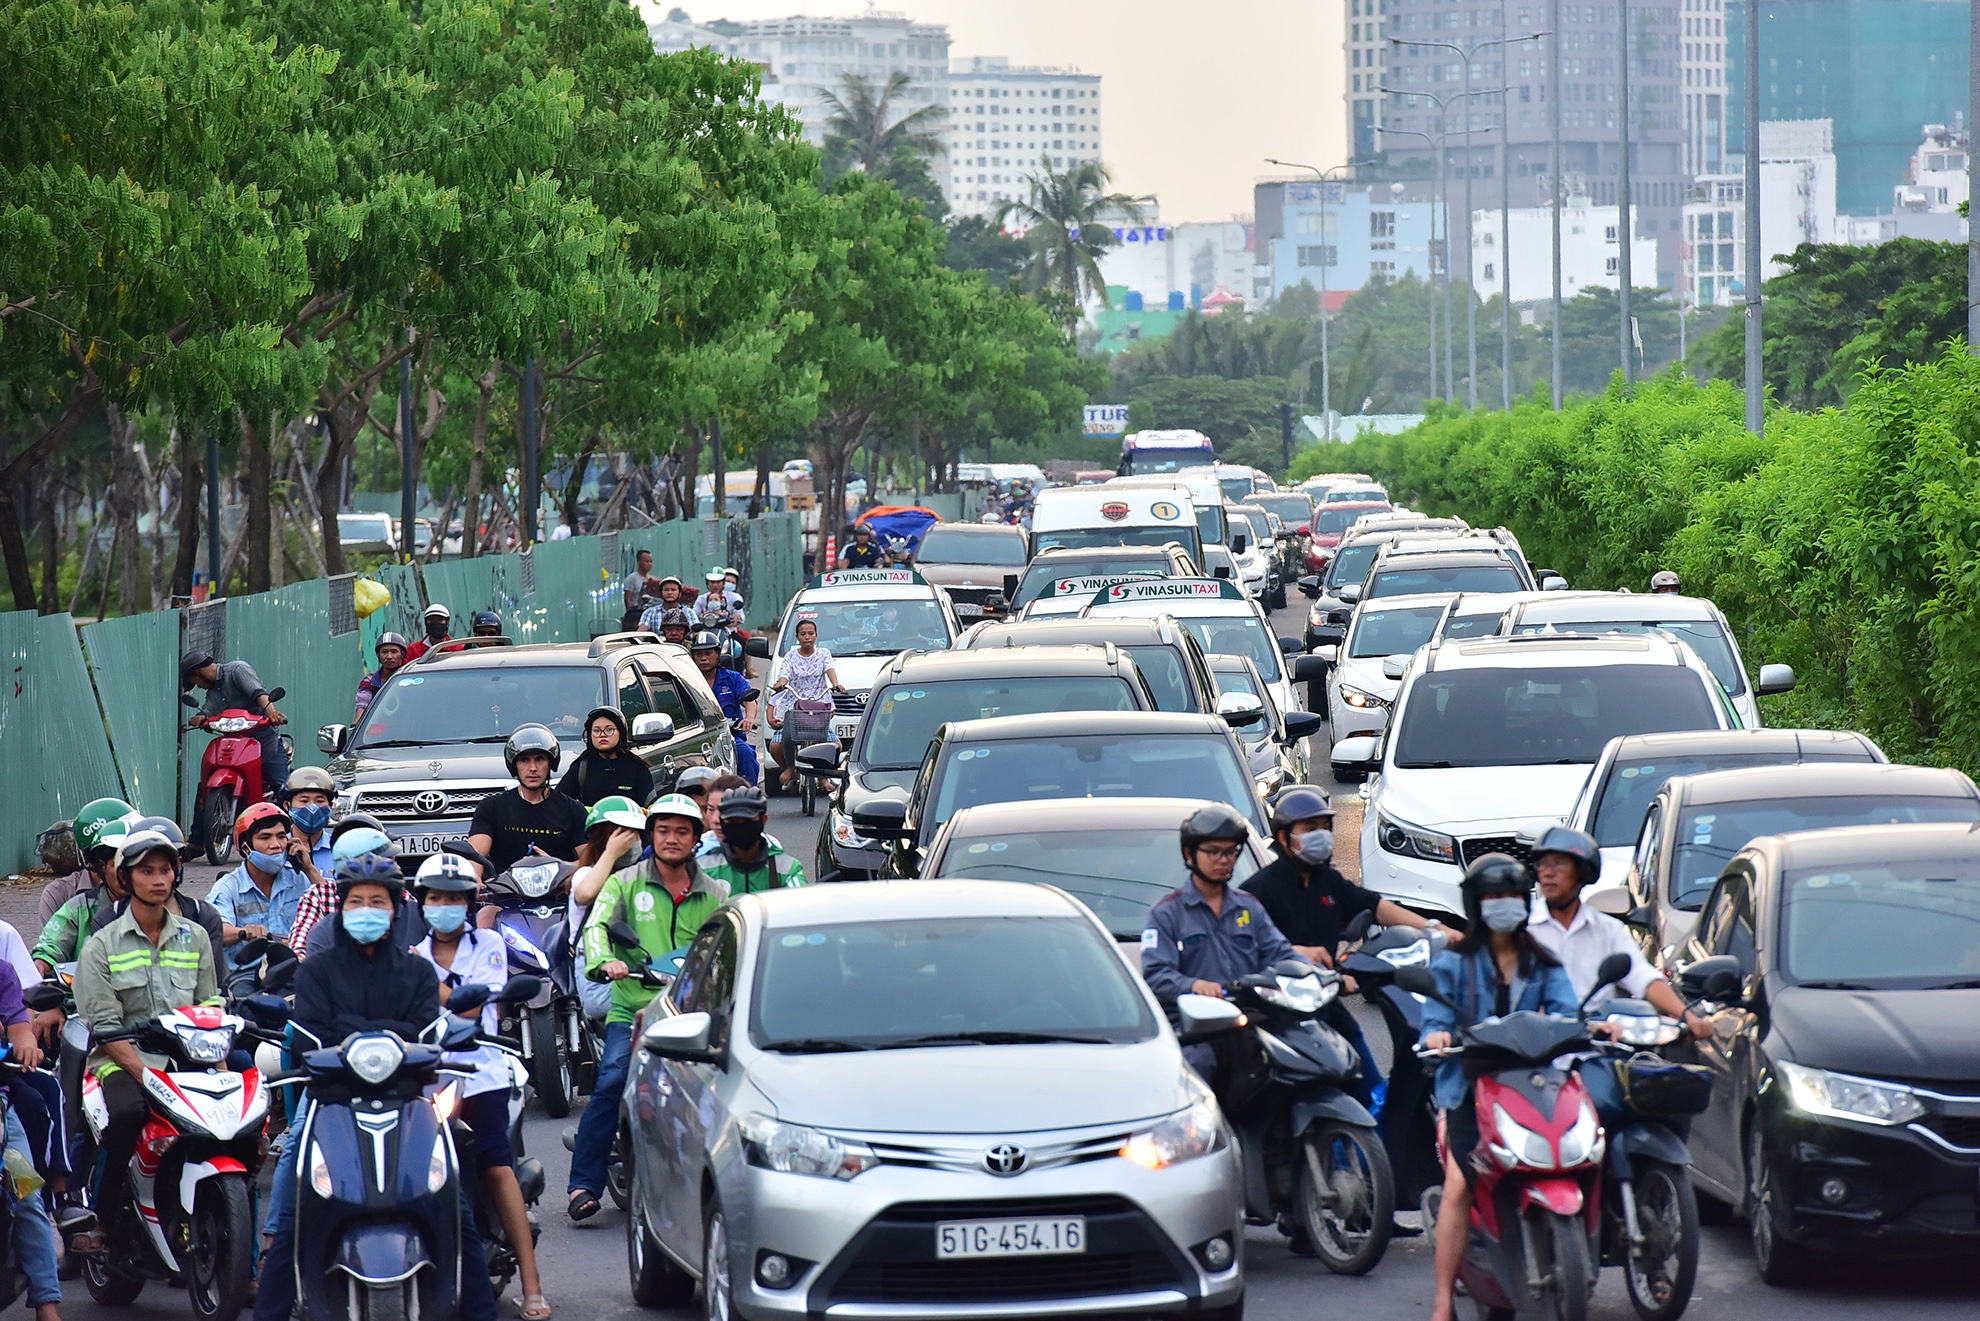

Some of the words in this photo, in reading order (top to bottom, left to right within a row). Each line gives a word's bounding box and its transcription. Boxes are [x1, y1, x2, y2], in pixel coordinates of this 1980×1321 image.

[1161, 505, 1169, 517] 1
[82, 817, 107, 837] Grab
[504, 825, 550, 835] LIVESTRONG
[635, 912, 656, 921] Grab
[148, 1078, 177, 1104] YAMAHA
[206, 1101, 239, 1125] 79
[942, 1221, 1081, 1254] 51G-454.16
